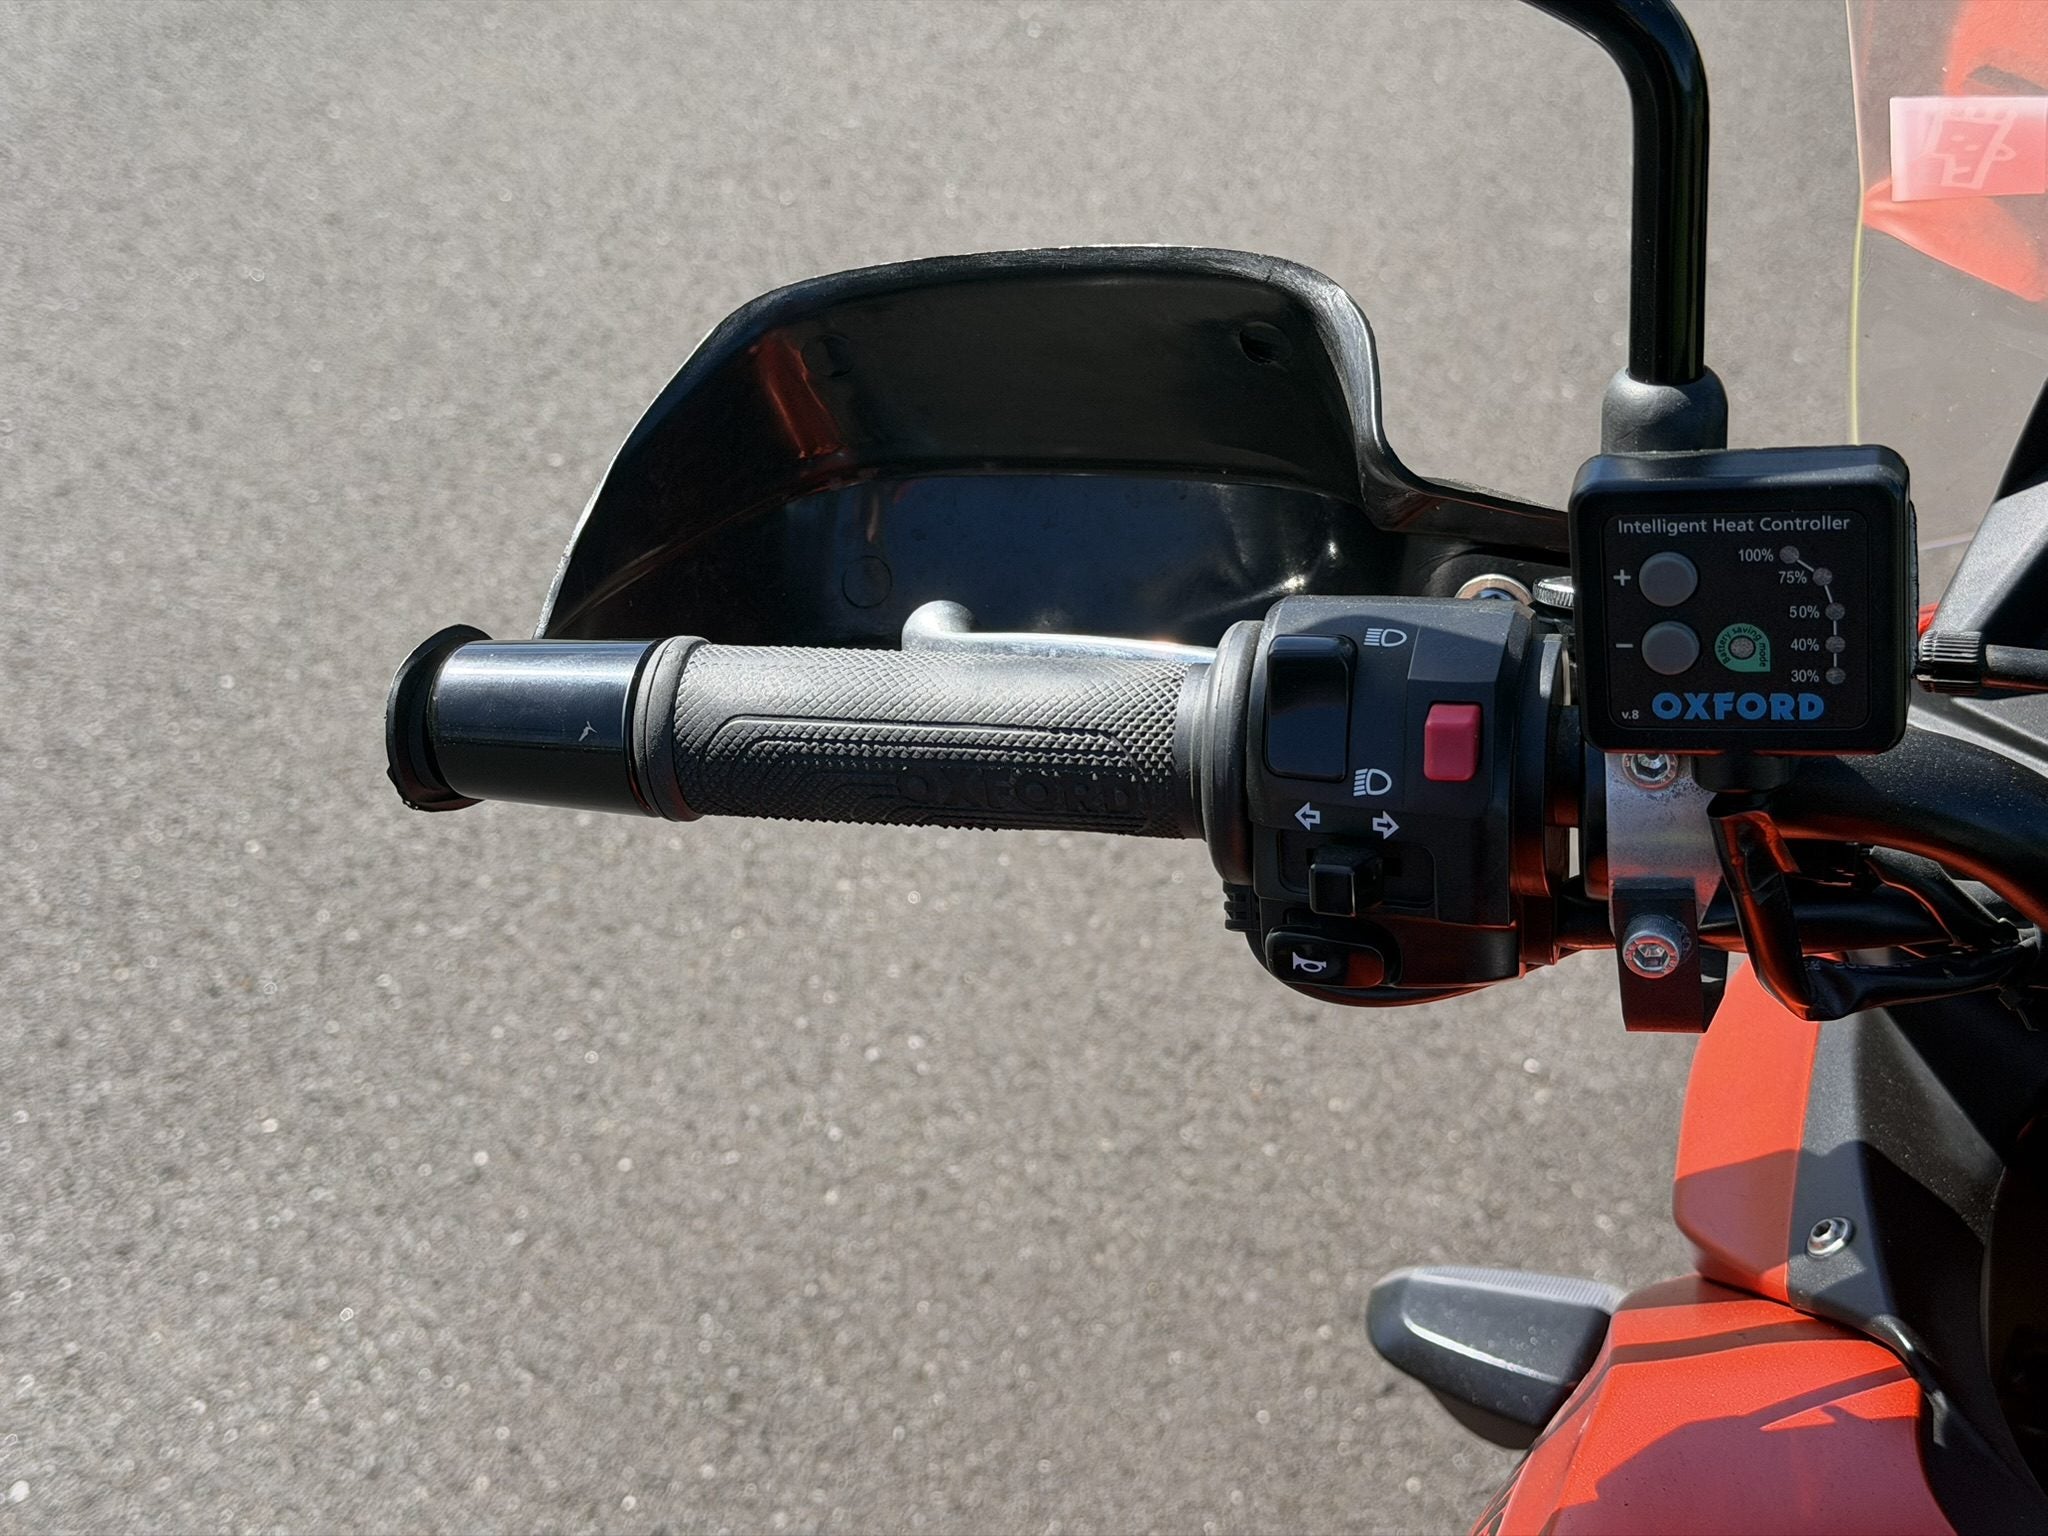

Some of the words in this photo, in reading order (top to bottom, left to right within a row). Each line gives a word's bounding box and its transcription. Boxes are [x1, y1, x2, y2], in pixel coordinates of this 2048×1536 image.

[1618, 518, 1707, 537] Intelligent
[1713, 518, 1754, 533] Heat
[1759, 515, 1850, 532] Controller
[1738, 548, 1774, 562] 100%
[1778, 570, 1807, 584] 75%
[1789, 605, 1820, 618] 50%
[1718, 631, 1731, 664] Battery
[1732, 626, 1762, 641] saving
[1759, 642, 1768, 667] mode
[1790, 638, 1820, 651] 40%
[1791, 670, 1820, 682] 30%
[1652, 692, 1825, 721] OXFORD
[1621, 709, 1640, 720] v.8
